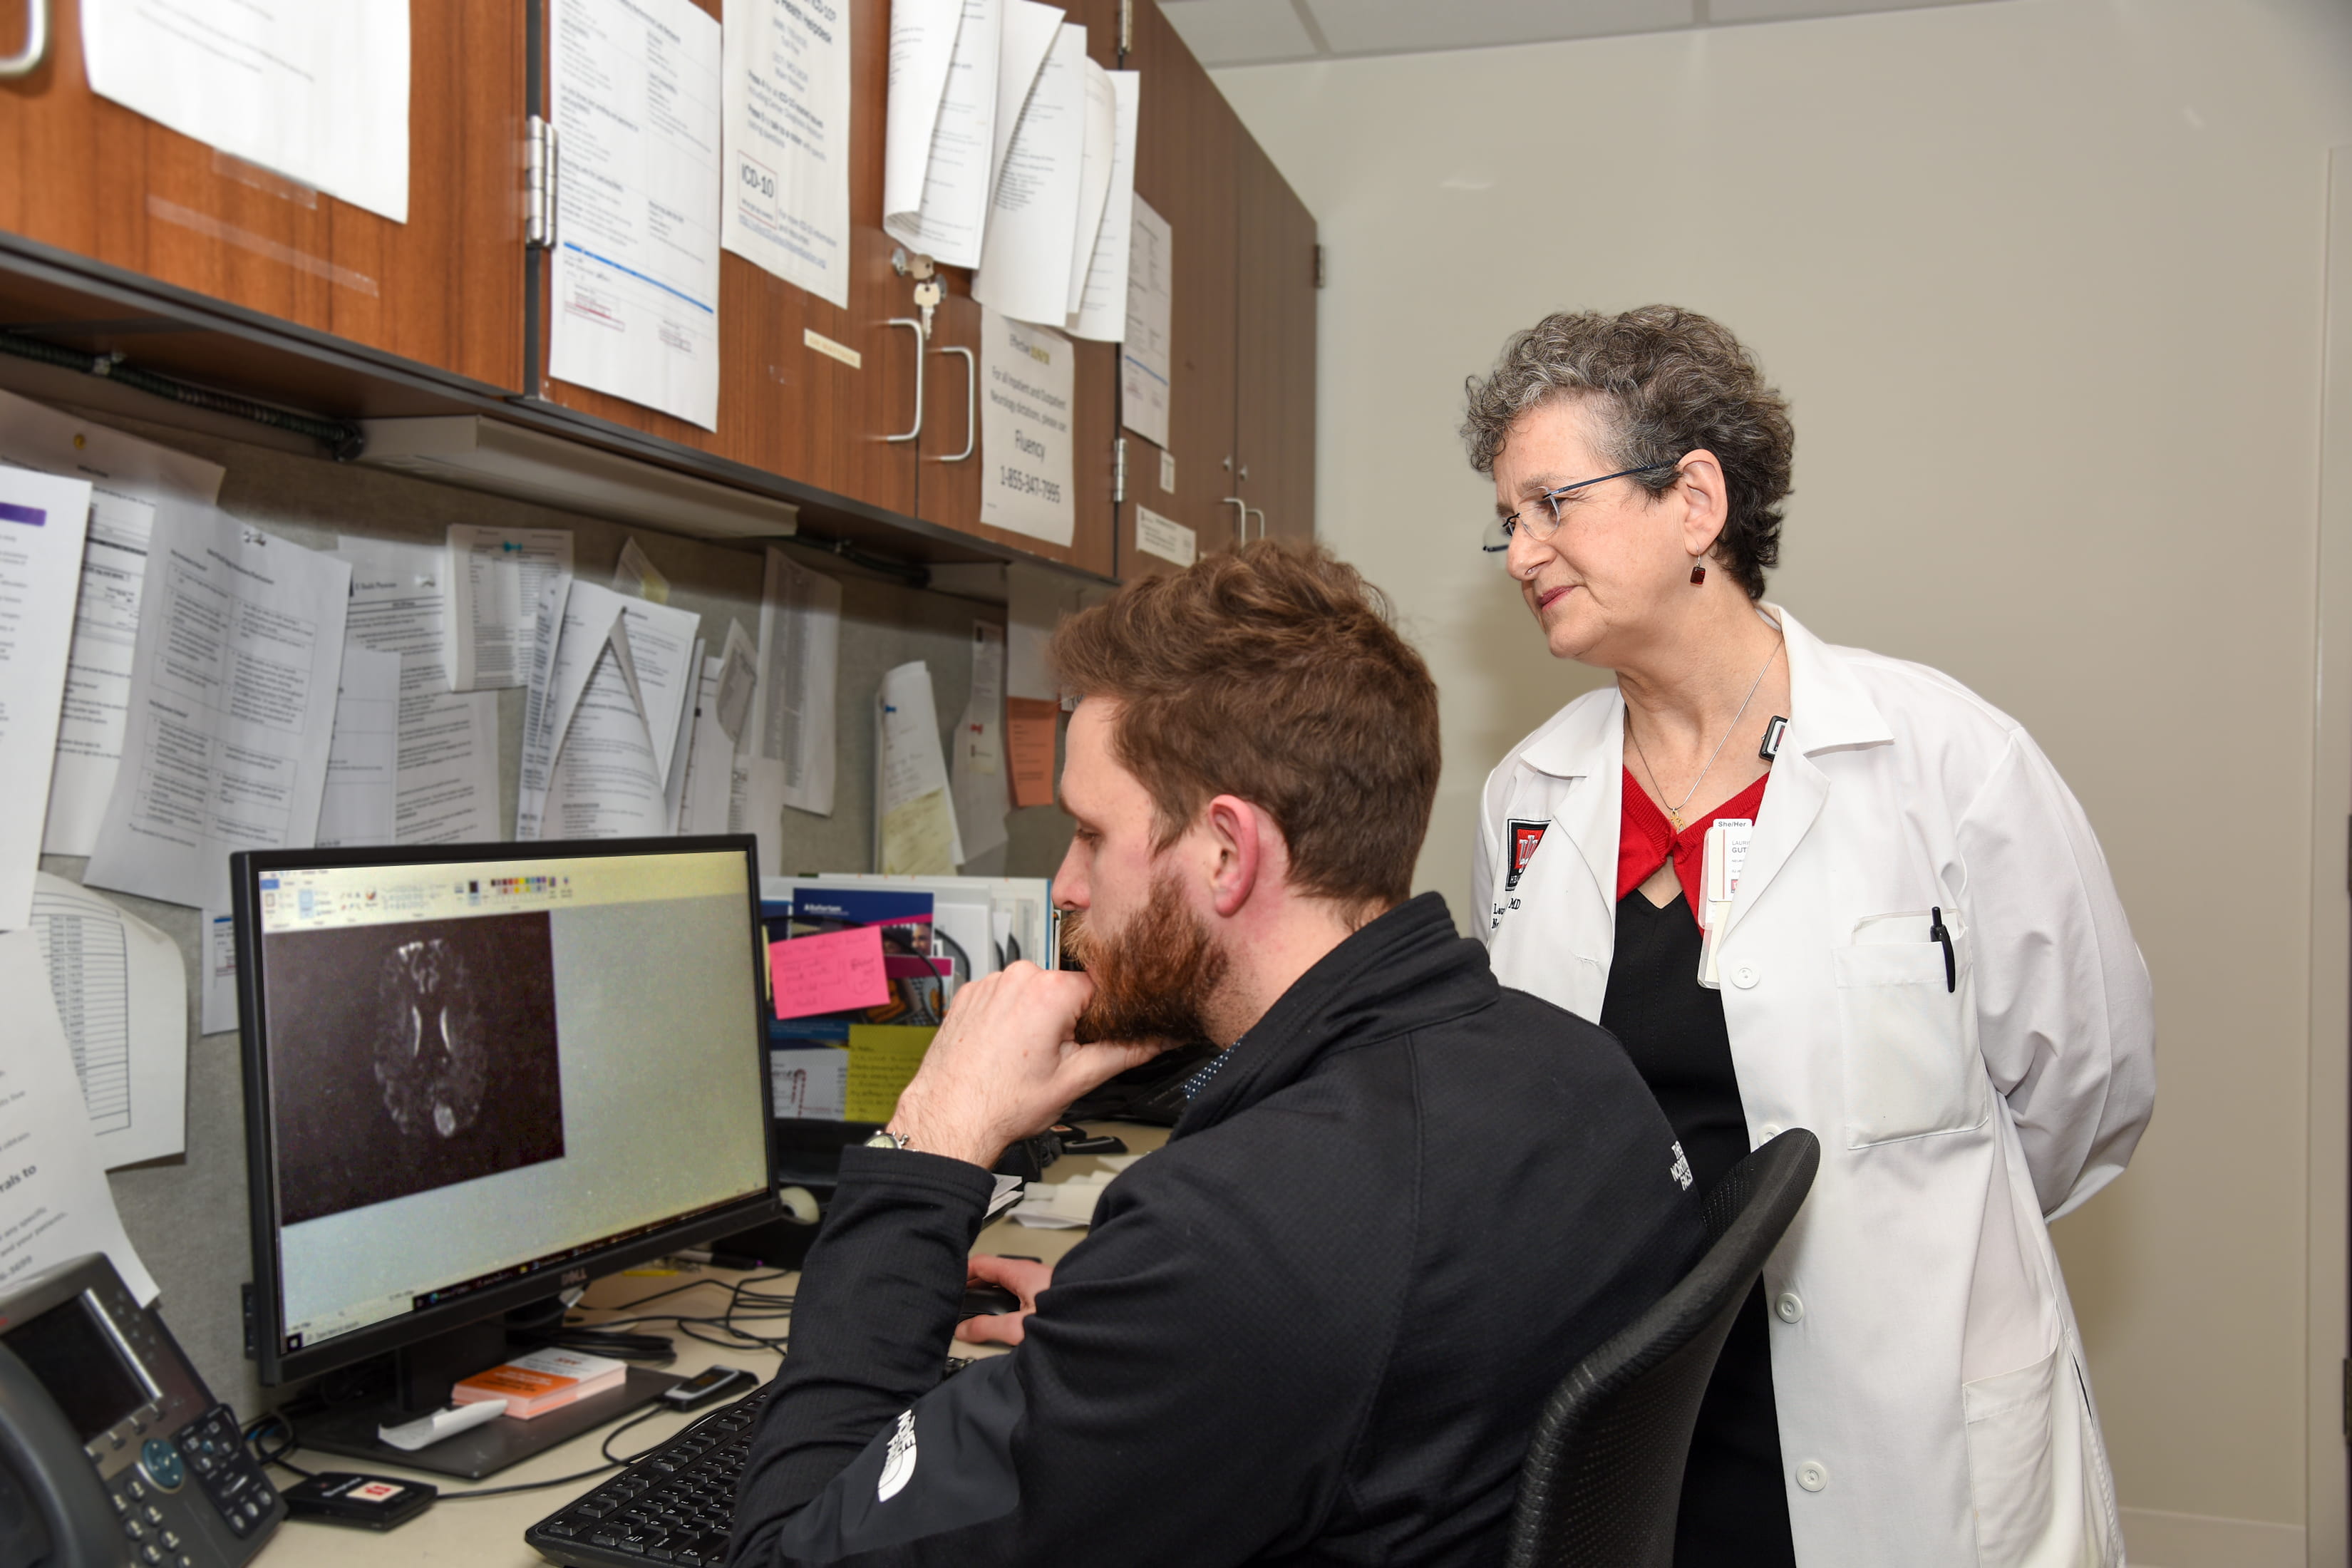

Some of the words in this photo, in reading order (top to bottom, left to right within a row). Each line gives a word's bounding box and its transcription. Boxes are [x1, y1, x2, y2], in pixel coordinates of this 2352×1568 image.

[742, 163, 775, 198] ICD-10
[1016, 429, 1045, 463] Fluency
[1508, 897, 1522, 910] MD
[22, 1164, 37, 1178] to
